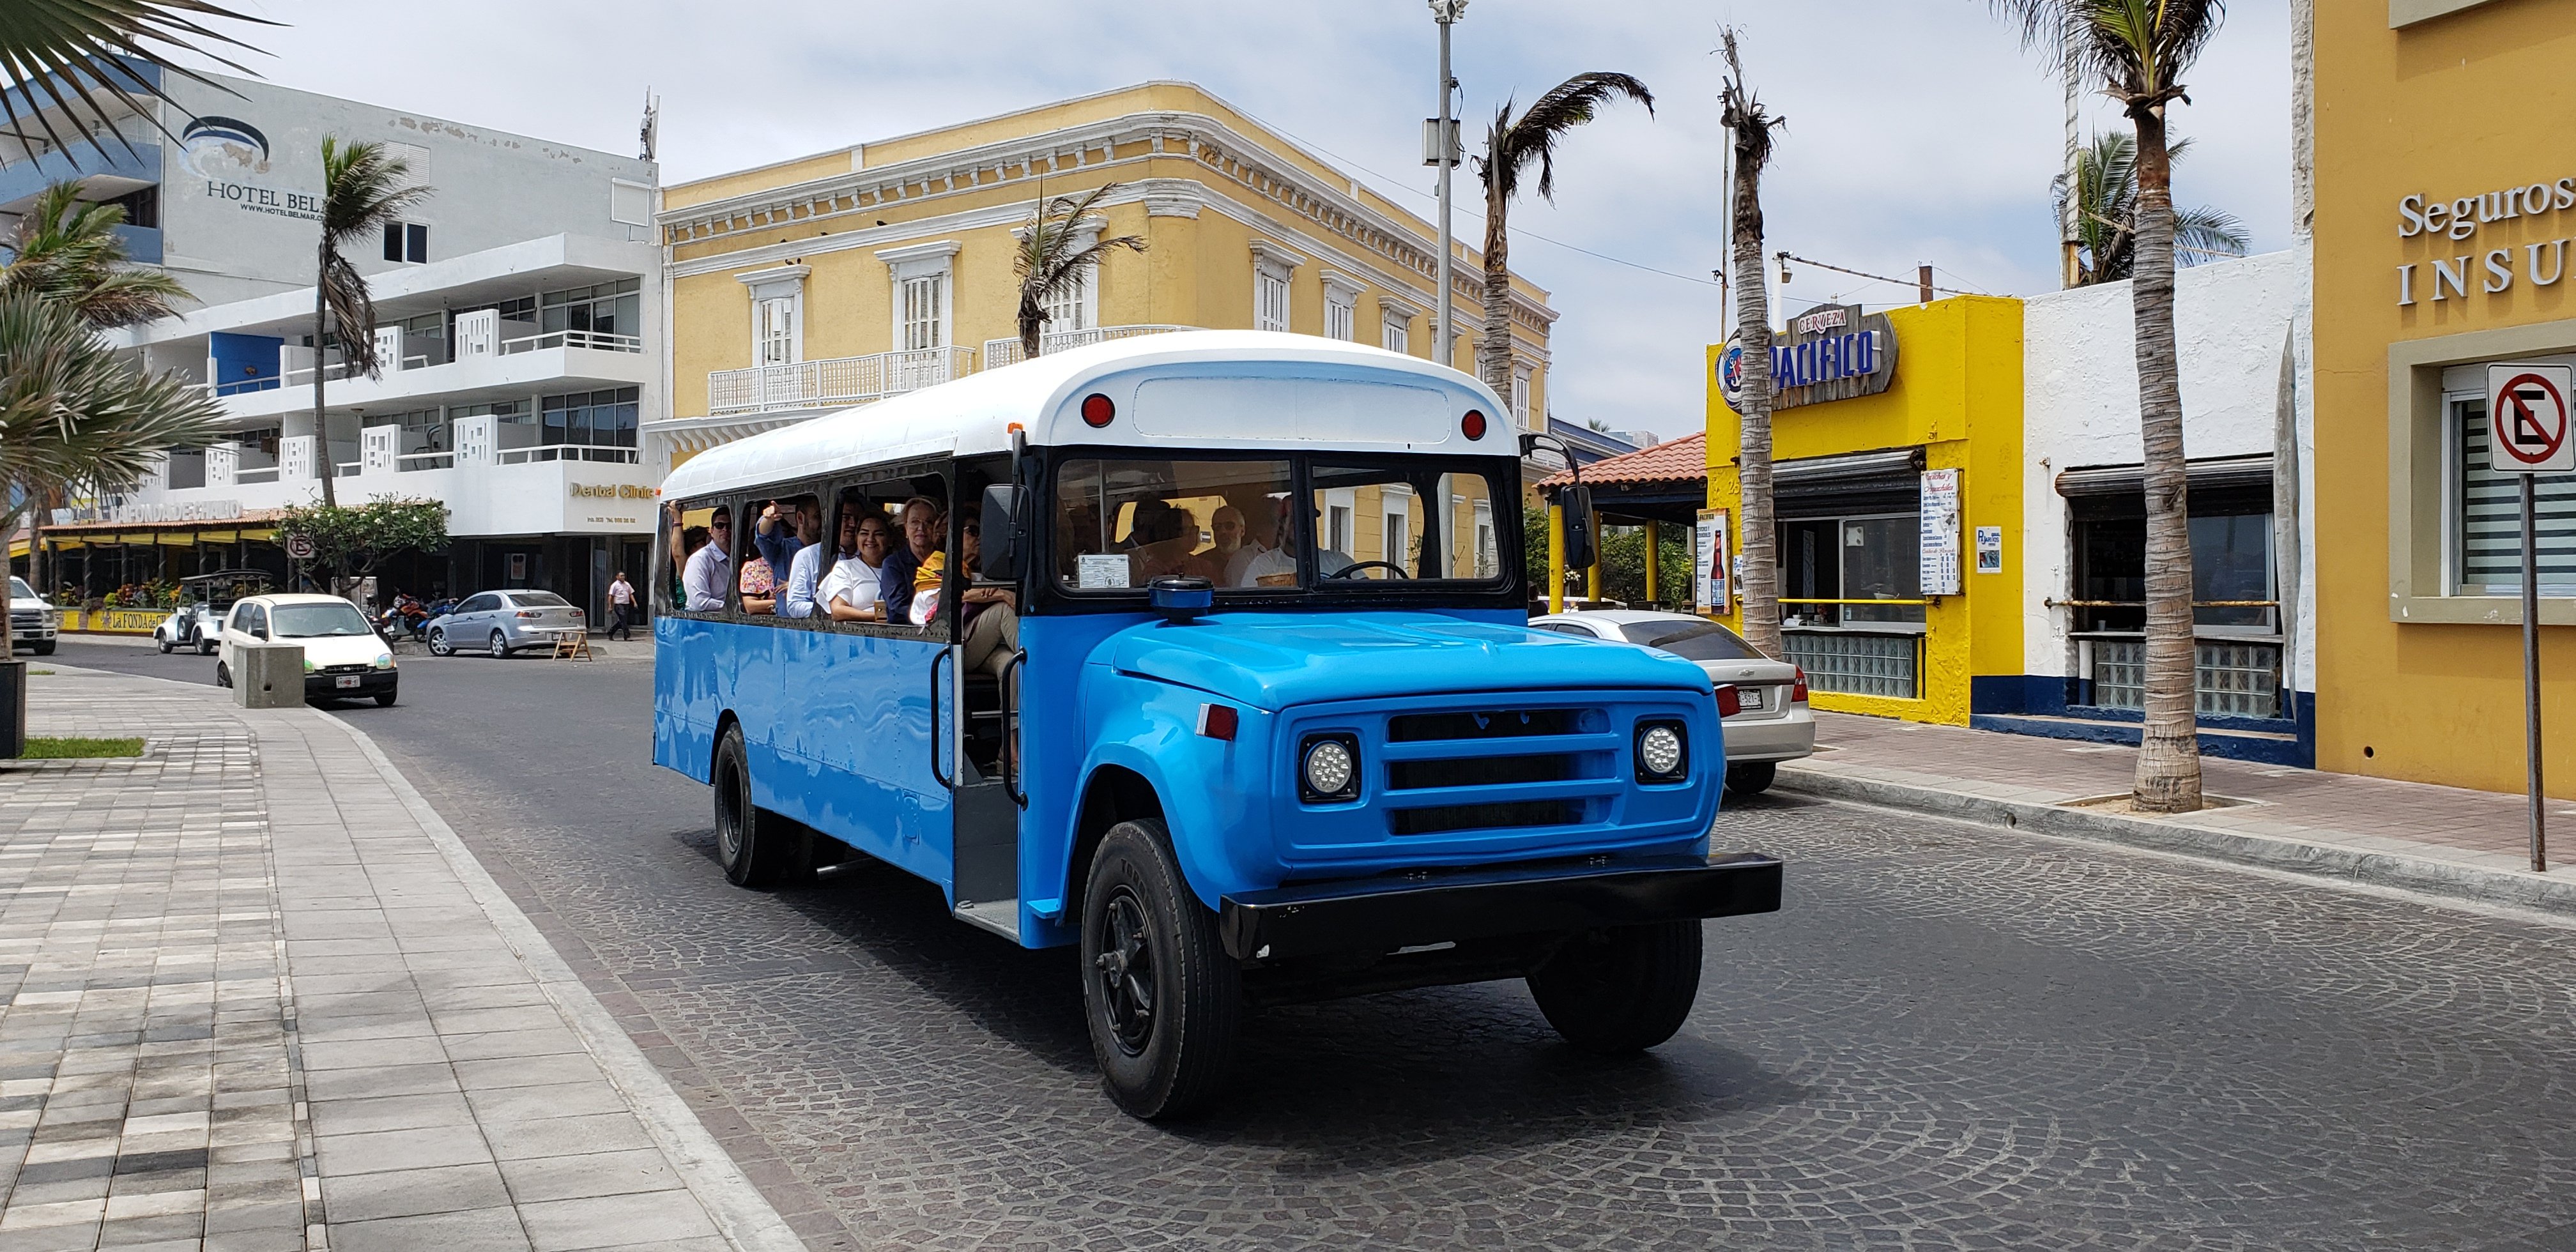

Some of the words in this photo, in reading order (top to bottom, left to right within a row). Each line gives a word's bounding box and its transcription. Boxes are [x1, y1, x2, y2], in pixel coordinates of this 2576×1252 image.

[207, 181, 280, 206] HOTEL
[2398, 177, 2576, 241] Seguros
[2396, 238, 2576, 306] INSU
[1799, 310, 1846, 334] CERVEZA
[1769, 330, 1873, 390] PACIFICO
[570, 482, 617, 498] Dental
[619, 484, 654, 499] Clinic
[113, 613, 122, 628] La
[123, 613, 148, 629] FONDA
[148, 615, 156, 629] de
